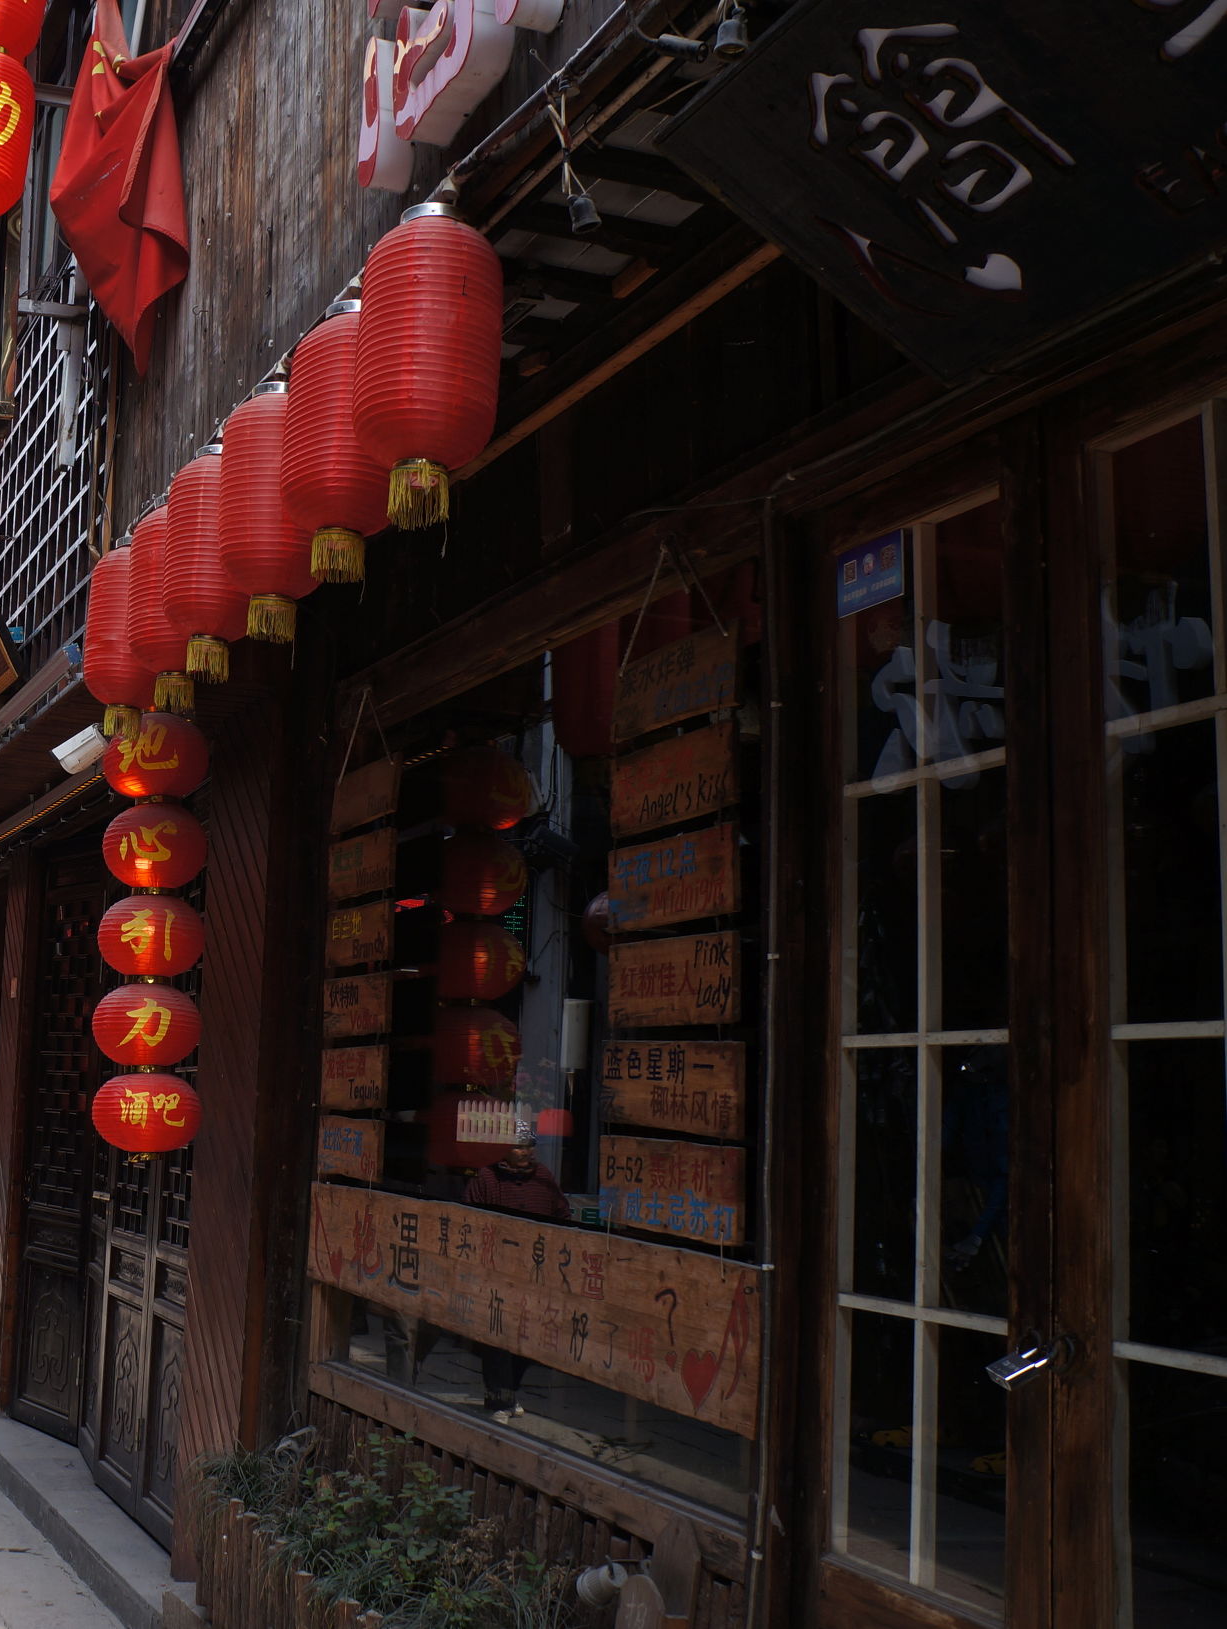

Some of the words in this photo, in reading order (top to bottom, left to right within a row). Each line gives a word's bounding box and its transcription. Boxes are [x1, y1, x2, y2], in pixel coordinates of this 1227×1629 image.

[119, 820, 178, 863] 心
[120, 908, 174, 962] 引
[621, 959, 697, 998] 红粉佳人
[696, 974, 732, 1015] Lady
[117, 997, 172, 1049] 力
[605, 1045, 714, 1085] 蓝色星期一
[118, 1087, 185, 1129] 酒吧
[606, 1155, 644, 1184] B-52
